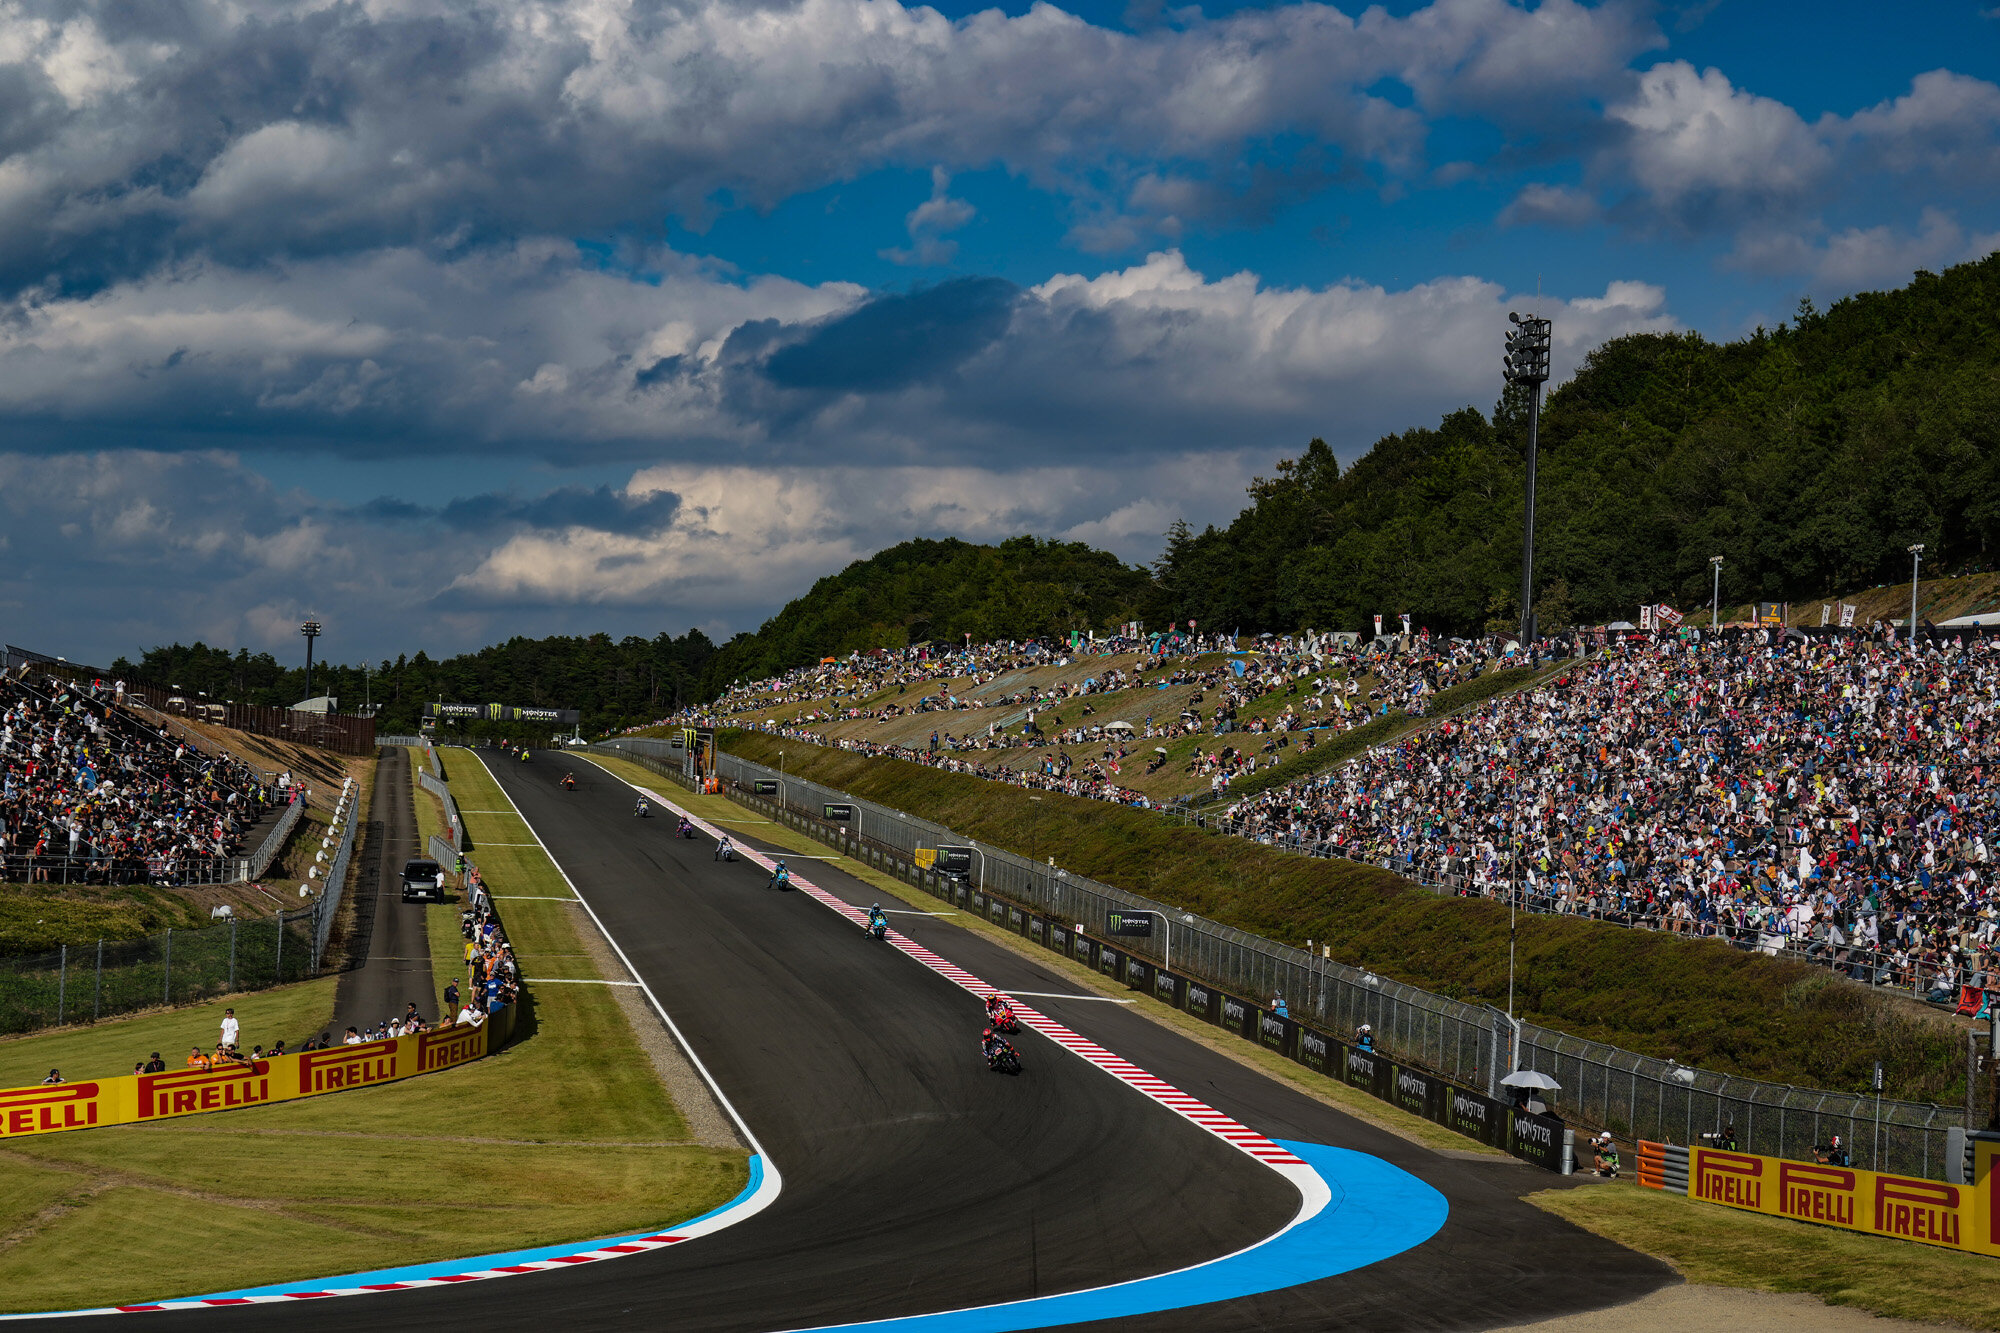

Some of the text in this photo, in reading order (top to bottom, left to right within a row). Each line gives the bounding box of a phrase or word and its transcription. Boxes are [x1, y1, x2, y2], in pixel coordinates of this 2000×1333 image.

[1771, 605, 1777, 616] Z
[417, 1023, 482, 1072] PIRELLI
[1304, 1031, 1326, 1057] MONSTER
[300, 1040, 397, 1094] PIRELLI
[1348, 1052, 1374, 1077] MONSTER
[138, 1061, 269, 1118] PIRELLI
[1399, 1071, 1426, 1098] MONSTER
[1454, 1094, 1485, 1122] MONSTER
[1458, 1118, 1480, 1132] ENERGY
[1514, 1117, 1550, 1146] MONSTER
[1520, 1142, 1545, 1157] ENERGY
[1696, 1150, 1762, 1208] PIRELLI
[1780, 1162, 1855, 1225] PIRELLI
[1875, 1176, 1960, 1244] PIRELLI
